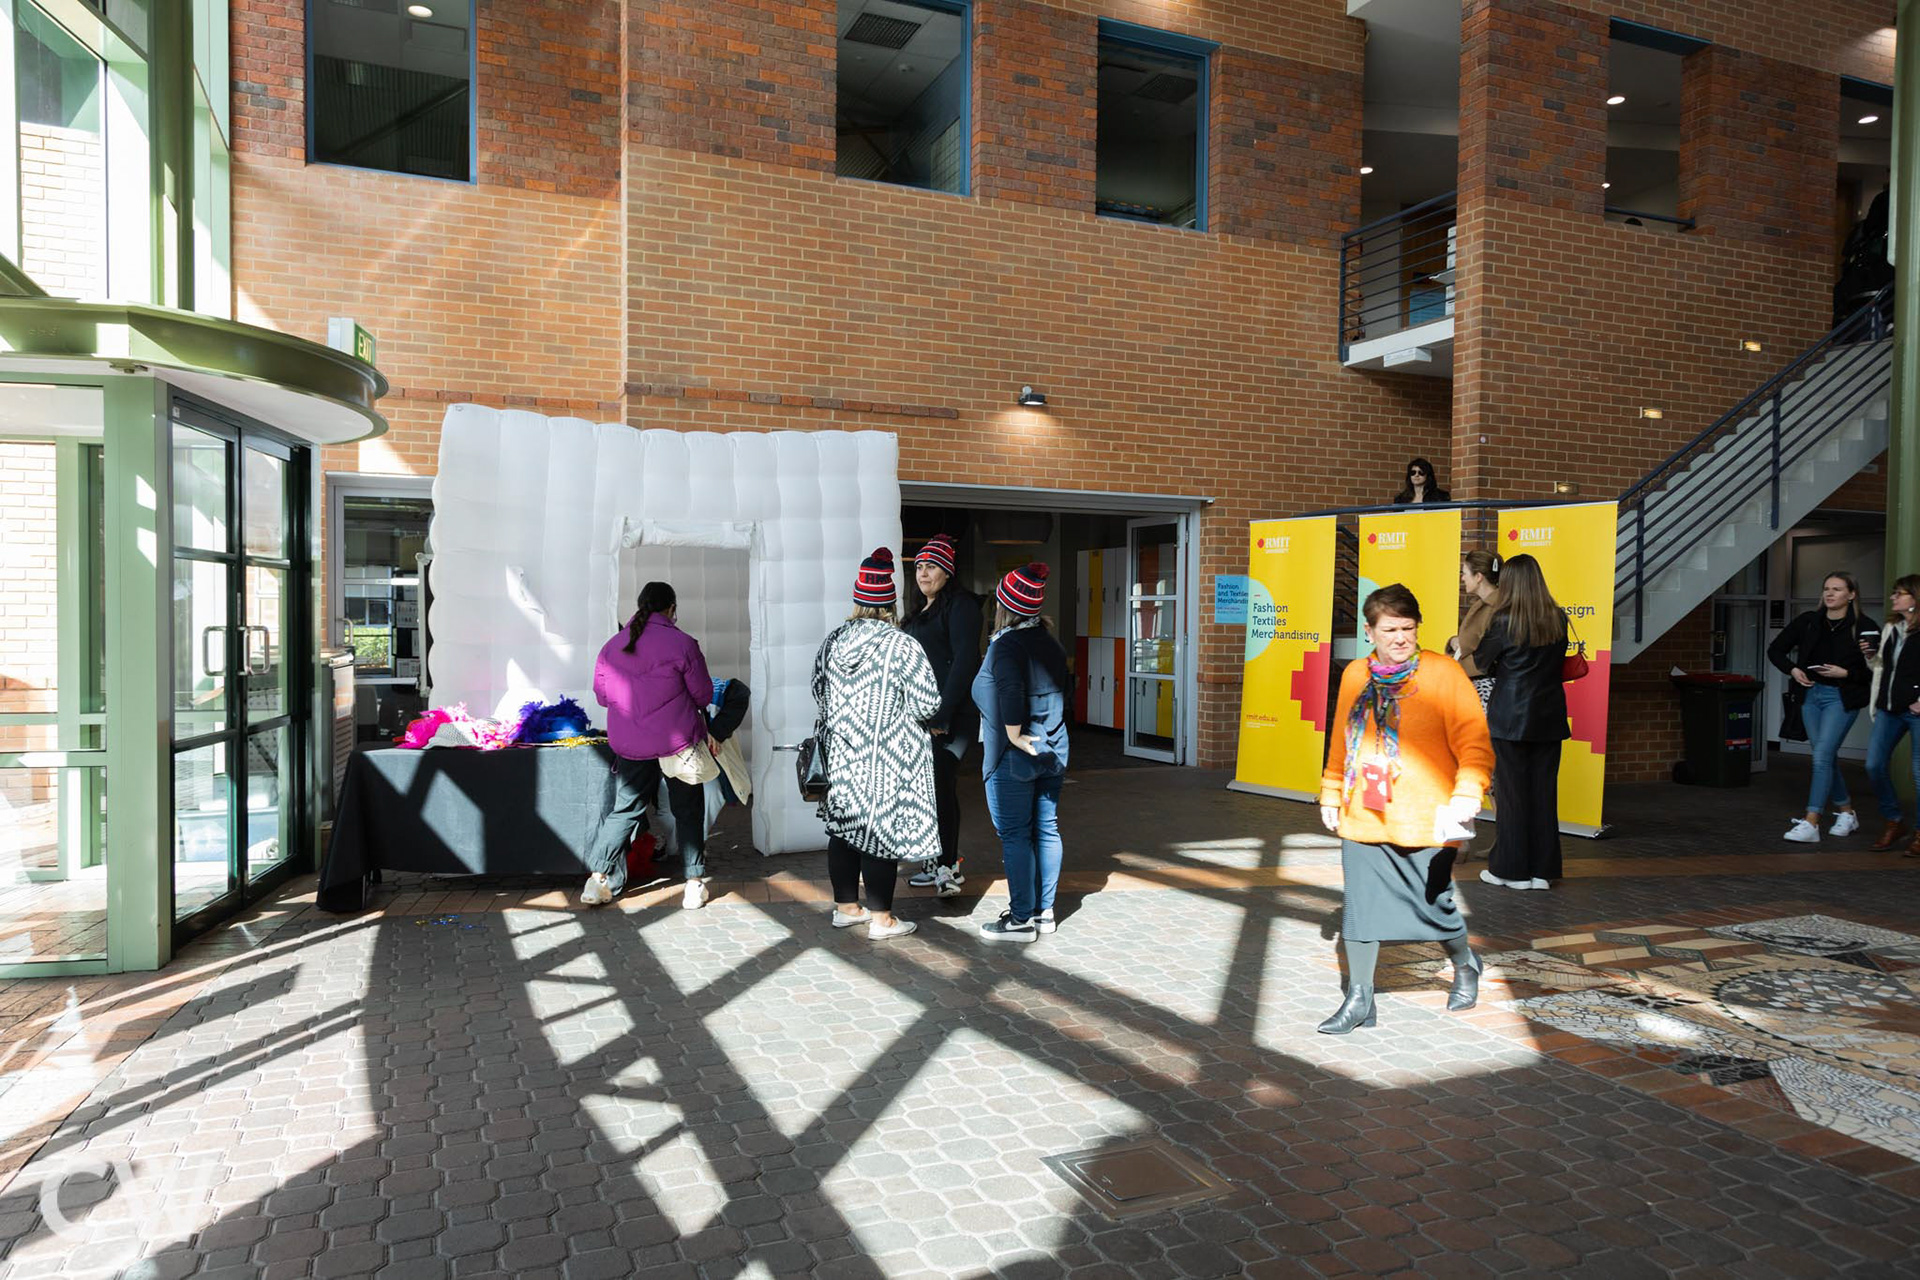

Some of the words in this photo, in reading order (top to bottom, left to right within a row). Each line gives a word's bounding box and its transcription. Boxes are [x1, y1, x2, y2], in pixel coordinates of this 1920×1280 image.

[358, 332, 372, 363] EXIT
[1378, 532, 1406, 544] RMIT
[1520, 527, 1552, 540] RMIT
[1265, 537, 1289, 548] RMIT
[1253, 603, 1289, 613] Fashion
[1252, 616, 1287, 626] Textiles
[1251, 629, 1320, 643] Merchandising
